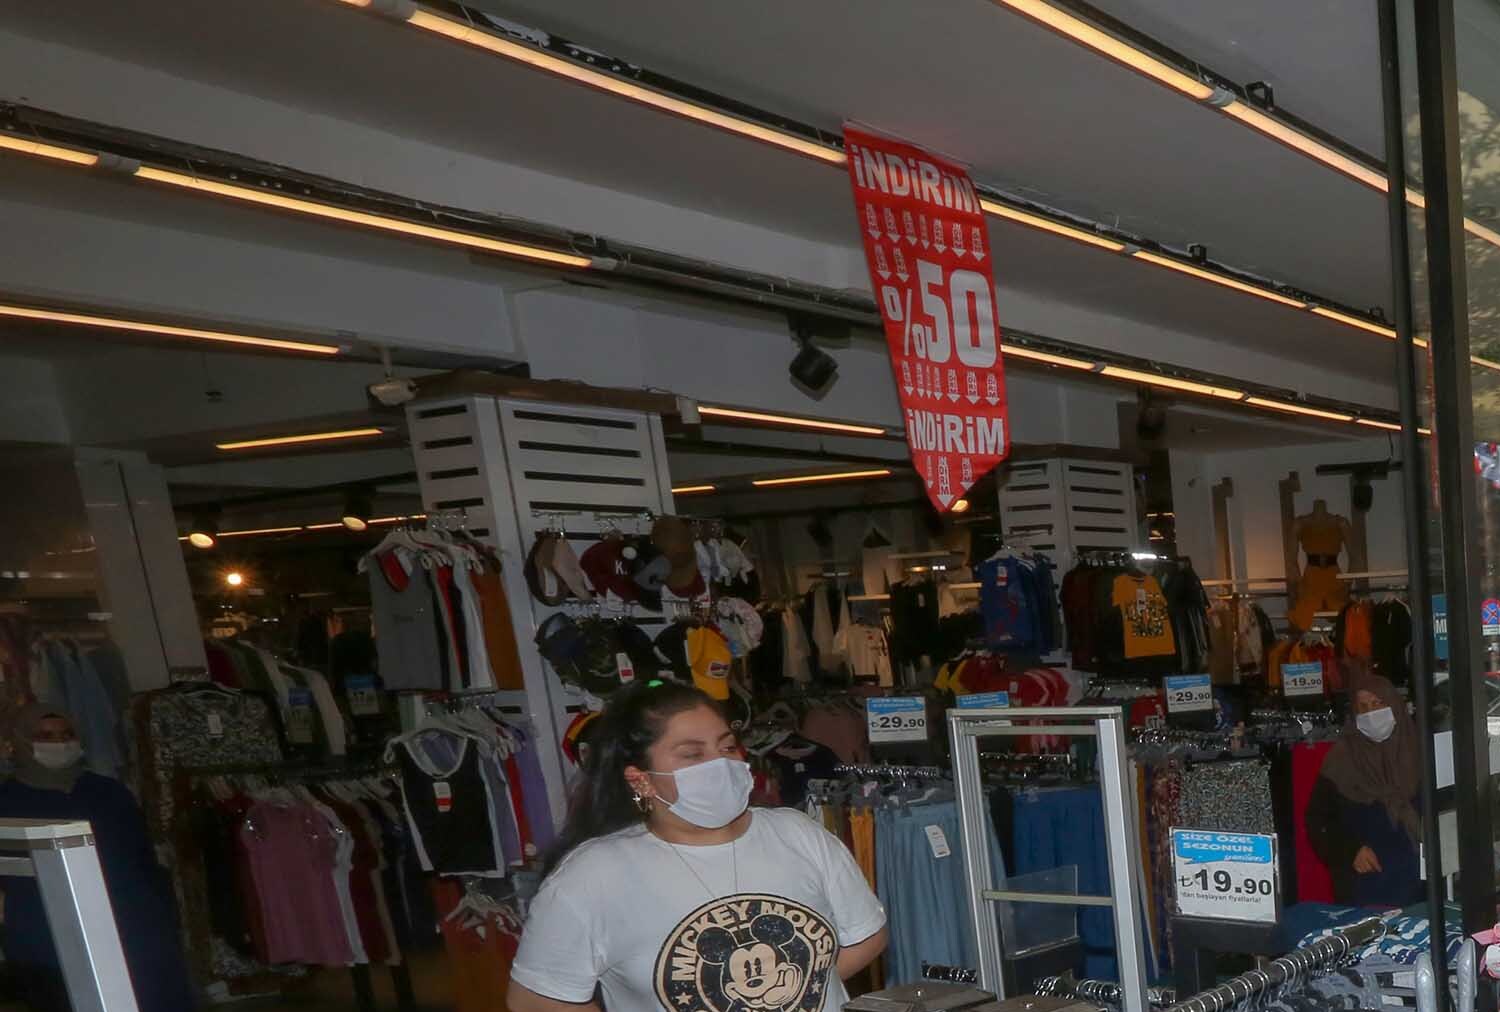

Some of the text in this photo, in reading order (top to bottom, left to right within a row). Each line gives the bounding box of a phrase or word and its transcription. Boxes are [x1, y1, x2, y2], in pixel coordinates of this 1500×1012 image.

[881, 259, 998, 368] %50
[671, 901, 833, 982] MICKEY MOUSE
